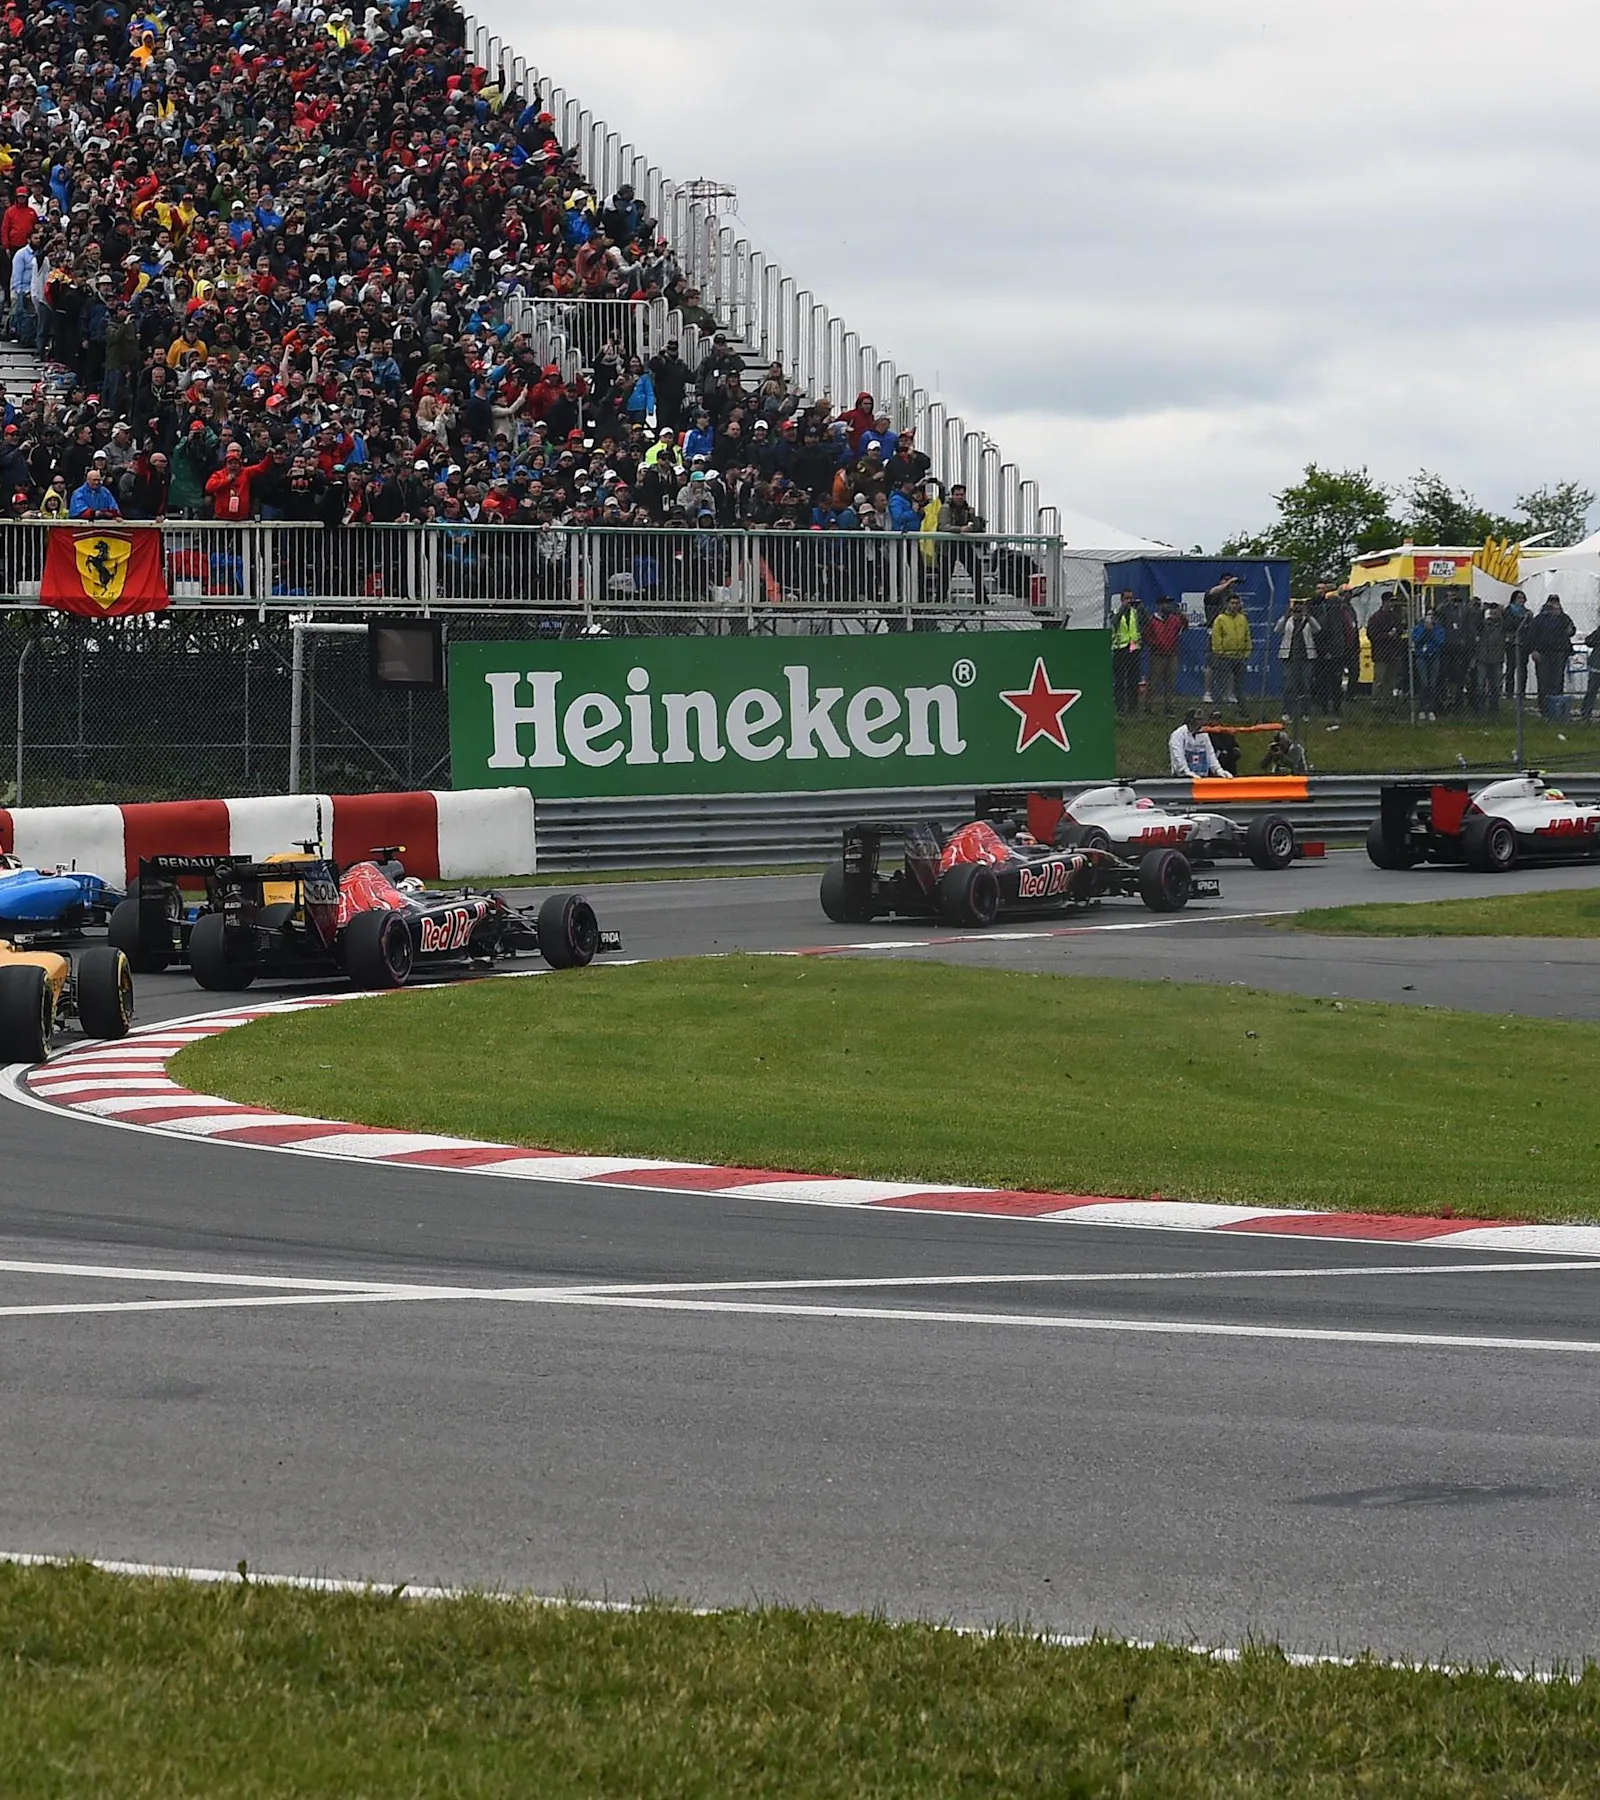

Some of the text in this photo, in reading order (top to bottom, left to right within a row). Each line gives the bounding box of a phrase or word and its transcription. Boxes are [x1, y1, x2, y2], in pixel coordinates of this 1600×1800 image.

[485, 666, 967, 768] Heineken
[1019, 863, 1050, 897] Red
[420, 911, 452, 952] Red
